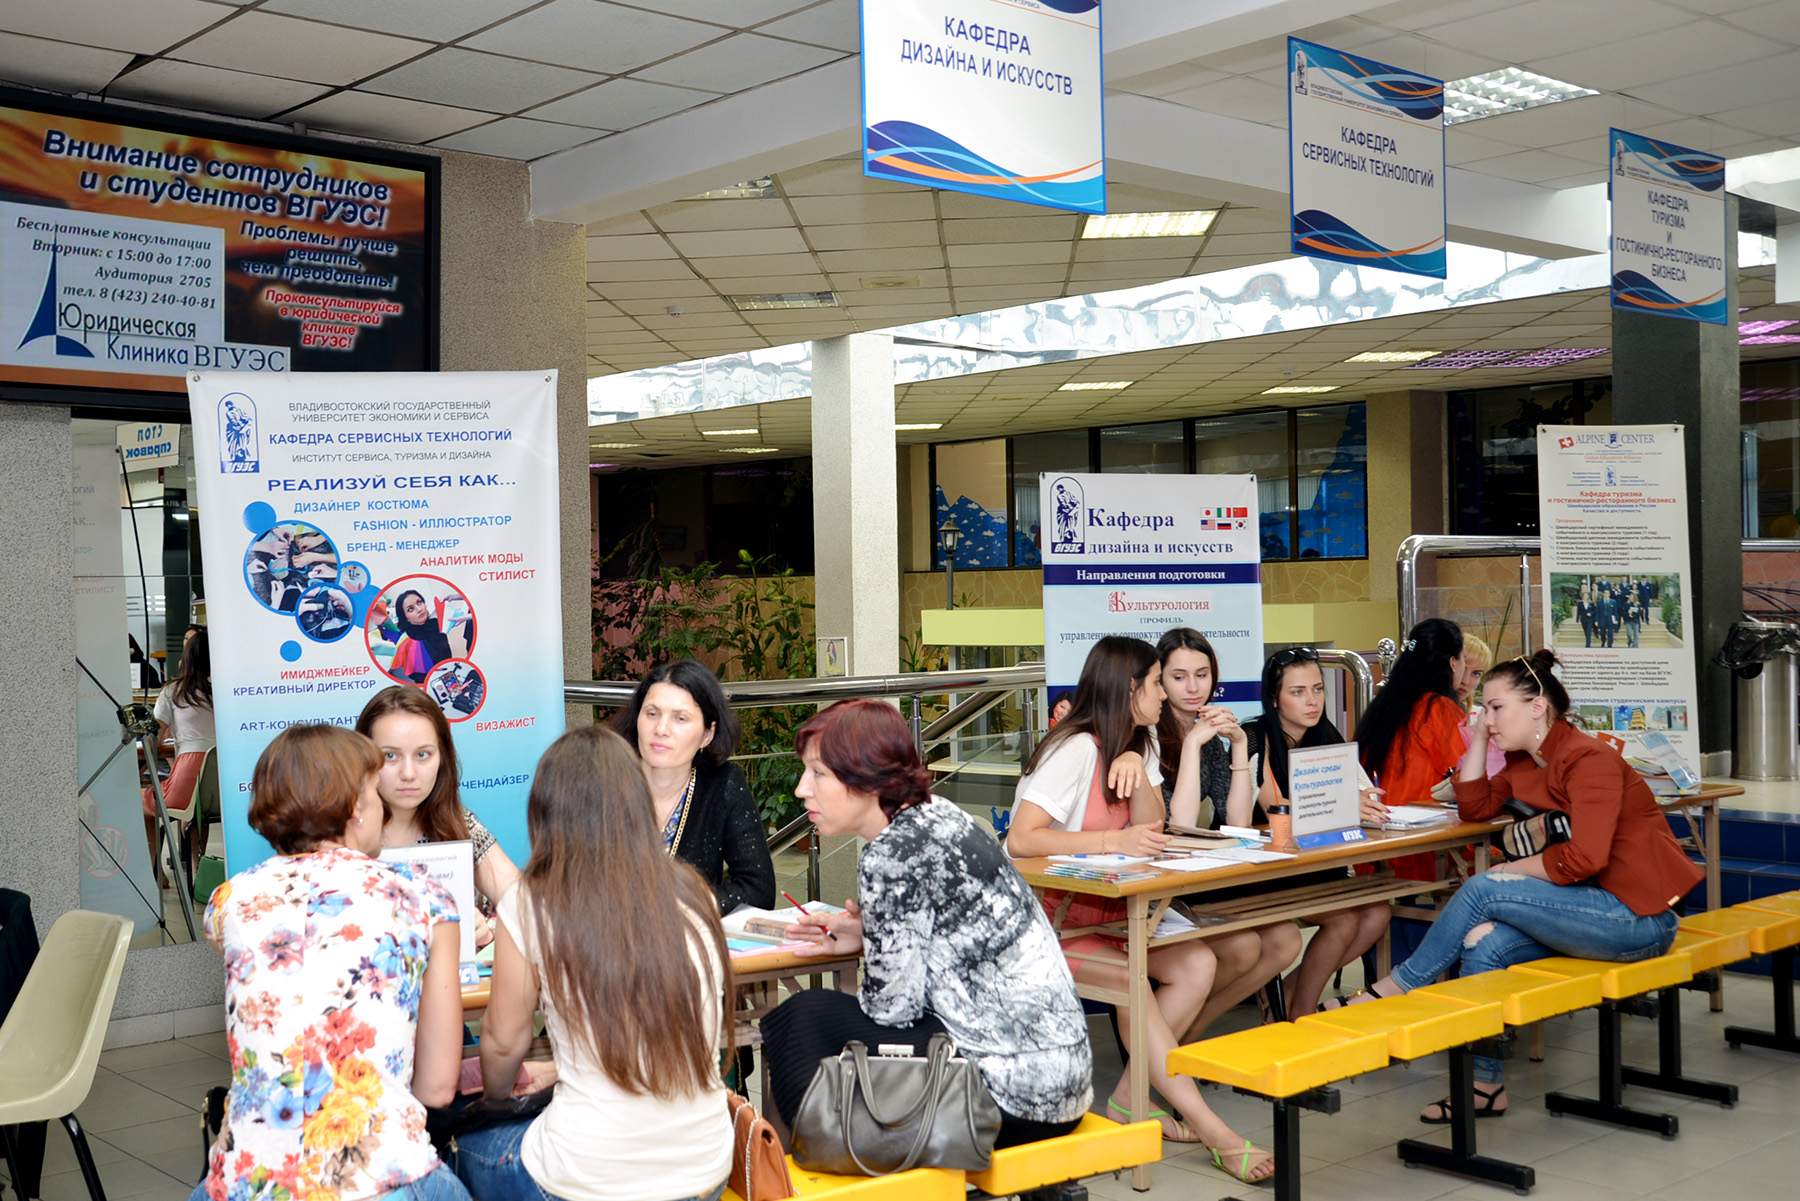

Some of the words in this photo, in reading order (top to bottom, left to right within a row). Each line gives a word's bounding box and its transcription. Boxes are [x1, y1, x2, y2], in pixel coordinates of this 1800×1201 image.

[944, 16, 1032, 55] КАФЕДРА
[901, 39, 977, 75] ДИЗАЙНА
[982, 56, 992, 77] И
[996, 60, 1073, 95] ИСКУССТВ
[1341, 126, 1397, 155] КАФЕДРА
[43, 129, 197, 174] Внимание
[205, 160, 389, 201] сотрудников
[1302, 142, 1367, 172] СЕРВИСНЫХ
[1369, 158, 1434, 188] ТЕХНОЛОГИЙ
[80, 171, 98, 189] и
[107, 173, 277, 213] студентов
[286, 193, 388, 227] ВГУЭС!
[1647, 189, 1690, 212] КАФЕДРА
[1651, 209, 1686, 229] ТУРИЗМА
[17, 216, 110, 239] Бесплатные
[112, 229, 212, 250] консультации
[240, 220, 335, 247] Проблемы
[340, 235, 395, 254] лучше
[1666, 231, 1672, 244] И
[32, 239, 103, 258] Вторник:
[106, 249, 113, 259] с
[117, 248, 154, 264] 15:00
[156, 252, 172, 265] до
[176, 255, 212, 269] 17:00
[286, 248, 363, 269] решить,
[1615, 237, 1722, 271] ГОСТИНИЧНО-РЕСТОРАННОГО
[95, 266, 173, 286] Аудитория
[179, 275, 212, 288] 2705
[241, 261, 274, 275] чем
[280, 263, 395, 288] преодолеть!
[1651, 263, 1687, 283] БИЗНЕСА
[63, 285, 95, 298] тел.
[99, 287, 108, 299] 8
[111, 288, 148, 305] (423)
[151, 293, 216, 309] 240-40-81
[266, 289, 401, 314] Проконсультируйся
[58, 302, 196, 344] Юридическая
[279, 307, 288, 316] в
[292, 308, 380, 325] юридической
[302, 322, 357, 335] клинике
[302, 334, 352, 348] ВГУЭС!
[107, 331, 188, 365] Клиника
[193, 345, 285, 372] ВГУЭС
[288, 401, 390, 412] ВЛАДИВОСТОКСКИЙ
[393, 400, 491, 411] ГОСУДАРСТВЕННЫЙ
[292, 413, 366, 422] УНИВЕРСИТЕТ
[369, 412, 431, 422] ЭКОНОМИКИ
[434, 412, 441, 420] И
[443, 412, 489, 421] СЕРВИСА
[269, 433, 333, 446] КАФЕДРА
[338, 432, 423, 444] СЕРВИСНЫХ
[426, 429, 512, 442] ТЕХНОЛОГИЙ
[1576, 433, 1605, 444] ALPINE
[1621, 433, 1655, 444] CENTER
[292, 454, 342, 463] ИНСТИТУТ
[345, 453, 392, 462] СЕРВИСА,
[395, 452, 438, 461] ТУРИЗМА
[440, 451, 446, 460] И
[449, 450, 491, 461] ДИЗАЙНА
[268, 474, 386, 491] РЕАЛИЗУЙ
[394, 475, 451, 488] СЕБЯ
[459, 474, 517, 487] КАК...
[294, 500, 361, 513] ДИЗАЙНЕР
[367, 499, 429, 510] КОСТЮМА
[353, 520, 408, 531] FASHION
[419, 516, 512, 529] ИЛЛЮСТРАТОР
[1088, 508, 1174, 531] Кафедра
[347, 542, 386, 553] БРЕНД
[396, 539, 460, 551] МЕНЕДЖЕР
[1088, 541, 1149, 554] дизайна
[1155, 544, 1164, 553] и
[1168, 543, 1233, 556] искусств
[420, 556, 485, 567] АНАЛИТИК
[488, 553, 524, 564] МОДЫ
[479, 569, 536, 582] СТИЛИСТ
[1076, 570, 1156, 583] Направления
[1159, 571, 1226, 582] подготовки
[1139, 616, 1184, 624] ПРОФИЛЬ
[280, 666, 370, 680] ИМИДЖМЕЙКЕР
[233, 682, 314, 696] КРЕАТИВНЫЙ
[317, 680, 376, 693] ДИРЕКТОР
[476, 717, 536, 731] ВИЗАЖИСТ
[461, 774, 529, 790] ЧЕНДАЙЗЕР
